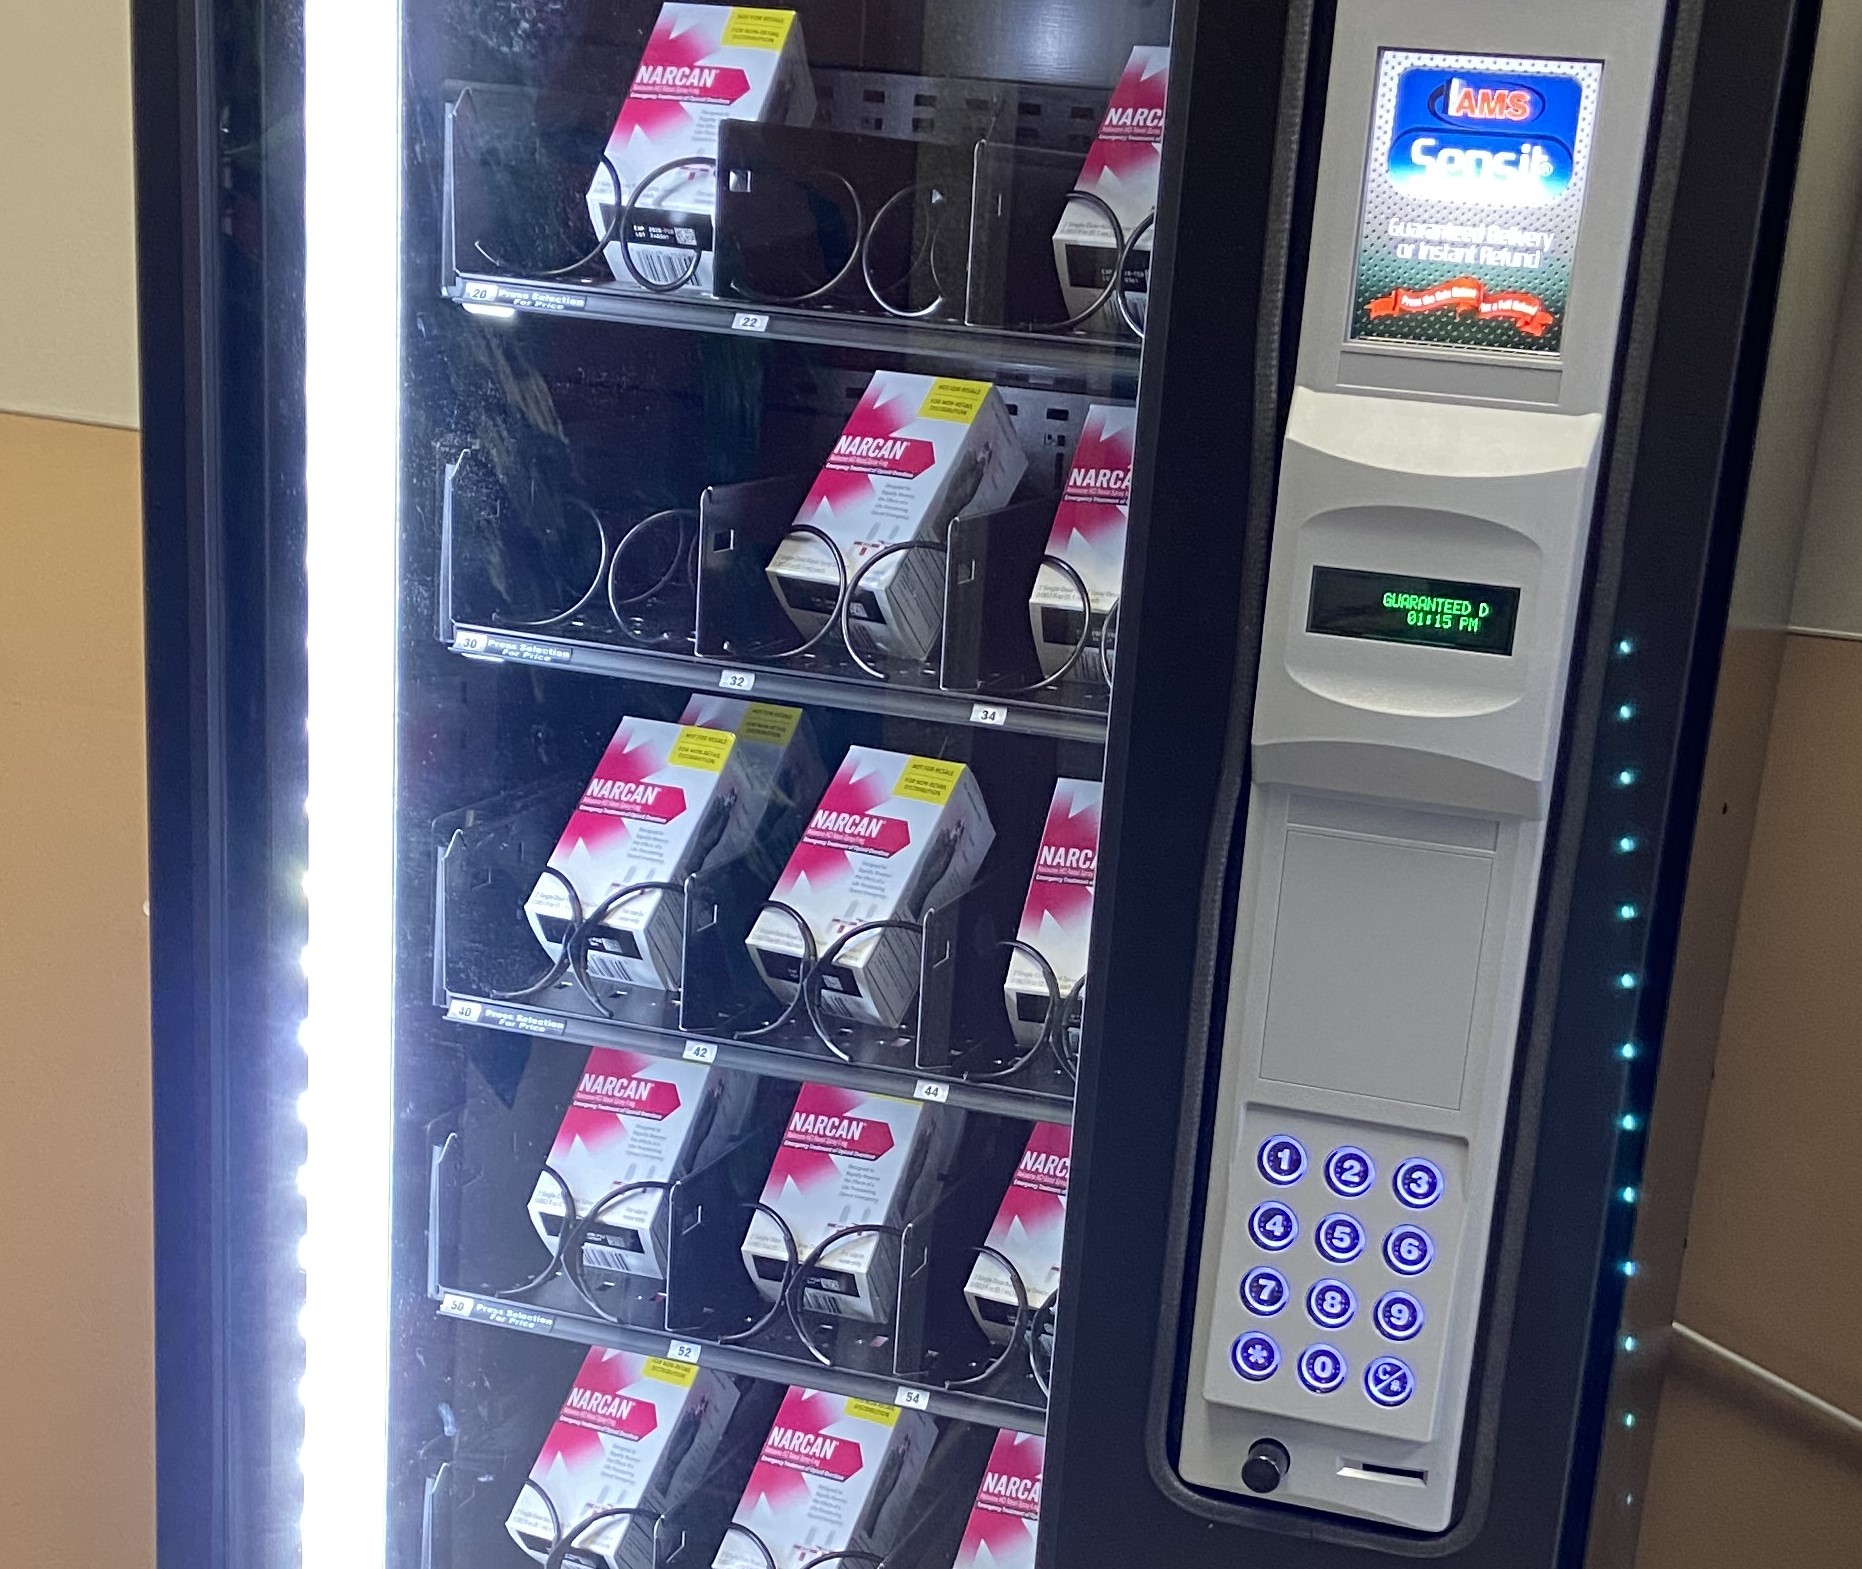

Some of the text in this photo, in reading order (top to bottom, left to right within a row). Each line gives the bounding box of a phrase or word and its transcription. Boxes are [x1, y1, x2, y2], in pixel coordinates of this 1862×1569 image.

[635, 64, 716, 88] NARCAN
[472, 288, 487, 299] 20
[498, 289, 585, 307] Press Selection
[513, 298, 564, 310] For Price
[742, 317, 758, 328] 22
[834, 434, 906, 460] NARCAN
[1383, 592, 1490, 618] GUARANTEED D
[1407, 610, 1479, 632] 01:15 PM
[463, 638, 478, 649] 30
[488, 640, 570, 658] Press Selection
[502, 649, 552, 662] For Price
[730, 675, 745, 687] 32
[981, 710, 996, 721] 34
[586, 778, 656, 805] NARCAN
[811, 809, 882, 838] NARCAN
[485, 1009, 565, 1029] Press Selection
[499, 1019, 545, 1032] For Price
[692, 1047, 708, 1058] 42
[579, 1073, 651, 1101] NARCAN
[924, 1086, 939, 1097] 44
[789, 1112, 863, 1140] NARCAN
[1020, 1150, 1069, 1179] NARC
[1278, 1149, 1290, 1170] 1
[1342, 1159, 1361, 1182] 2
[1409, 1171, 1429, 1194] 3
[1265, 1214, 1285, 1236] 4
[1332, 1225, 1351, 1247] 5
[1400, 1238, 1420, 1260] 6
[1259, 1279, 1276, 1301] 7
[451, 1301, 465, 1312] 50
[1324, 1290, 1343, 1313] 8
[476, 1303, 553, 1326] Press Selection
[508, 1318, 535, 1329] Price
[1390, 1304, 1409, 1326] 9
[678, 1346, 692, 1358] 52
[1313, 1355, 1333, 1377] 0
[567, 1387, 633, 1420] NARCAN
[906, 1392, 920, 1404] 54
[768, 1425, 836, 1460] NARCAN
